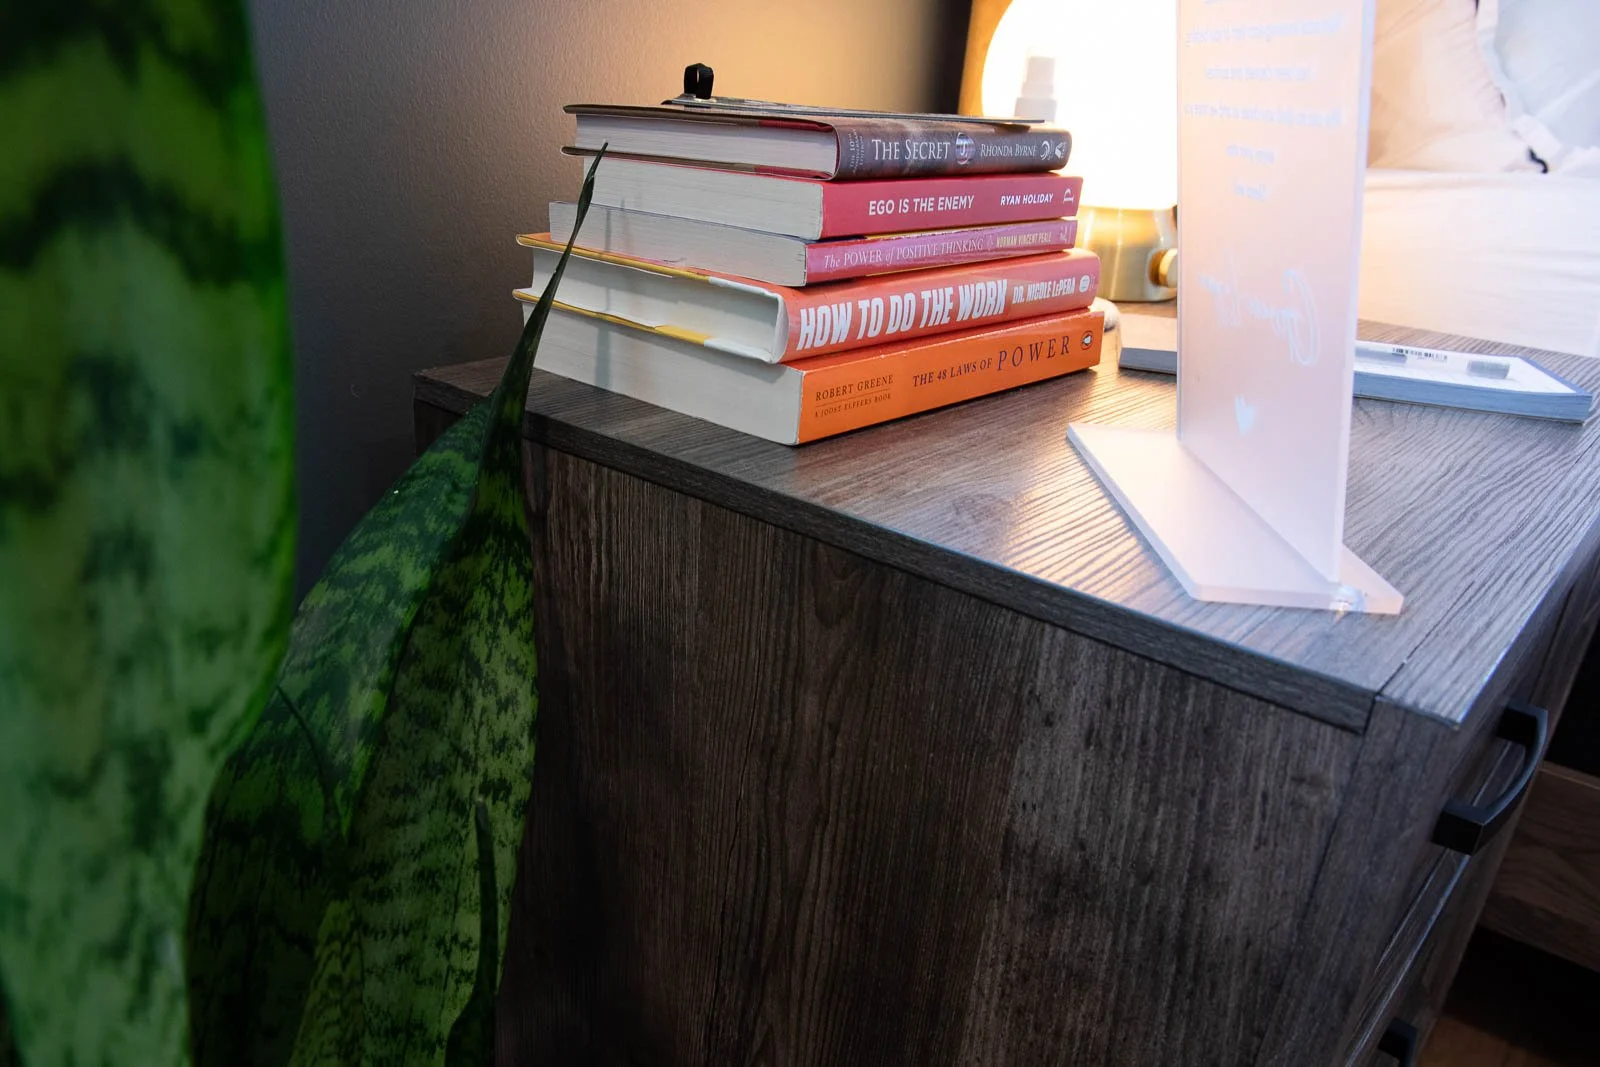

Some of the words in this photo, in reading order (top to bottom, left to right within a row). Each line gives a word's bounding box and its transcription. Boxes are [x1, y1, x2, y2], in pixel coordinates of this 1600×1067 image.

[871, 139, 900, 161] THE
[904, 138, 951, 160] SECRET
[980, 143, 1013, 158] RHONDA
[1014, 143, 1036, 157] BYRNE
[868, 198, 895, 216] EGO
[898, 197, 910, 214] IS
[913, 196, 936, 213] THE
[937, 194, 975, 211] ENEMY
[1000, 195, 1021, 206] RYAN
[1022, 192, 1054, 205] HOLIDAY
[824, 254, 841, 268] The
[843, 250, 883, 267] POWER
[885, 249, 895, 265] of
[896, 243, 940, 261] POSITIVE
[940, 237, 984, 255] THINKING
[1012, 287, 1025, 305] DR.
[1025, 281, 1052, 303] NICOLE
[796, 301, 852, 351] HOW
[856, 296, 884, 341] TO
[886, 292, 917, 335] DO
[918, 287, 955, 328] THE
[956, 279, 1008, 322] WORK
[912, 373, 935, 388] THE
[936, 368, 948, 381] 48
[949, 361, 977, 379] LAWS
[979, 357, 993, 371] OF
[996, 334, 1071, 372] POWER
[815, 382, 854, 402] ROBERT
[857, 374, 894, 393] GREENE
